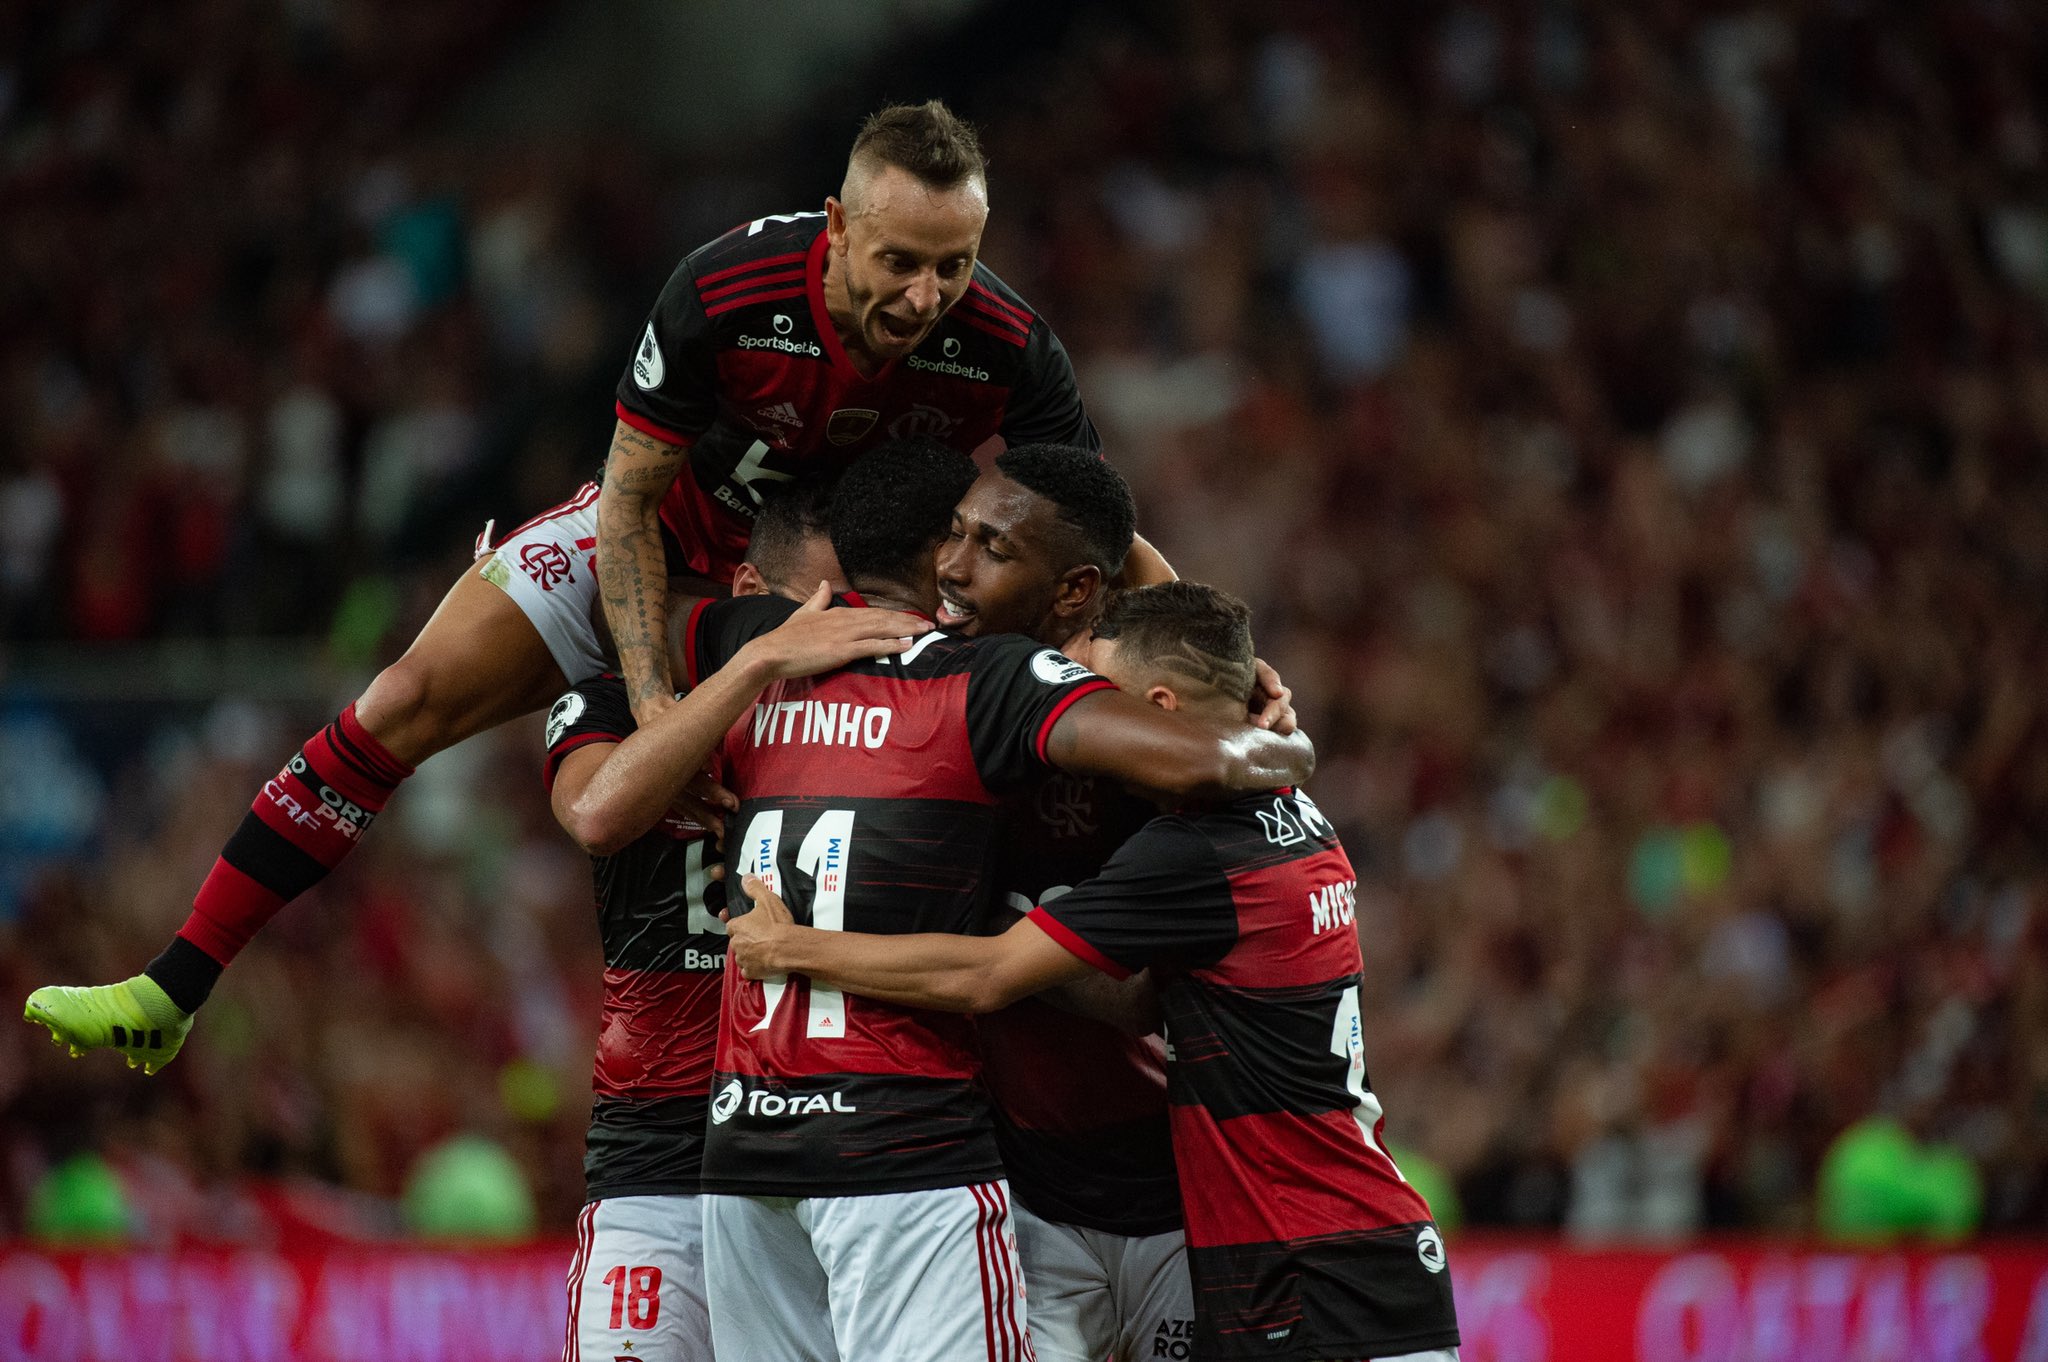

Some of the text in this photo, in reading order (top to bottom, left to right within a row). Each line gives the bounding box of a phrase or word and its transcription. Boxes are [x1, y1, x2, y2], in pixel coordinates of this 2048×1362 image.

[738, 334, 821, 357] Sportsbet.io
[907, 355, 989, 381] Sportsbet.io
[757, 407, 804, 428] adidas
[713, 484, 761, 521] Ban
[754, 699, 892, 749] VITINHO
[760, 837, 772, 872] TIM
[825, 837, 842, 871] TIM
[734, 809, 856, 1039] 11
[1351, 1015, 1359, 1050] TIM
[748, 1090, 857, 1117] TOTAL
[602, 1265, 663, 1331] 18
